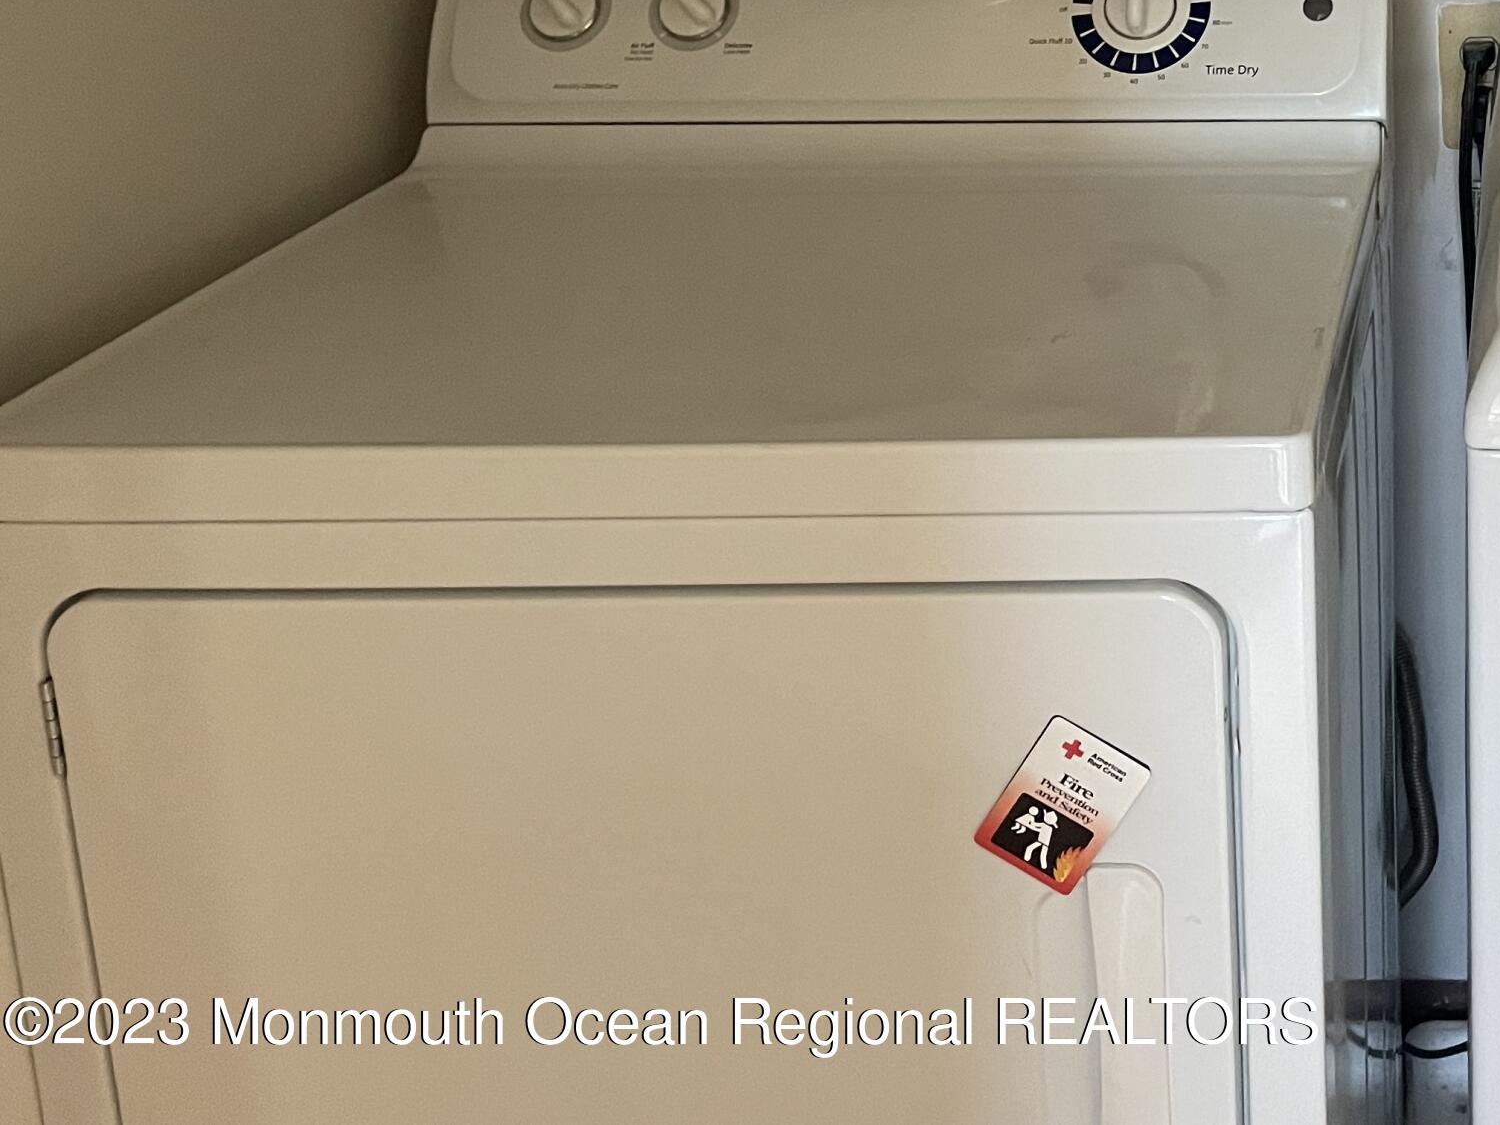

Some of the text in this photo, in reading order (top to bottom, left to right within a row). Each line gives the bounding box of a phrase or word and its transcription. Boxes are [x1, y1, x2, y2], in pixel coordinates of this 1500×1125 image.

[1206, 65, 1259, 78] Time Dry
[1087, 758, 1123, 782] Red Cross
[1091, 753, 1126, 777] American
[1040, 777, 1100, 817] Prevention
[1058, 773, 1095, 801] Fire
[1035, 789, 1093, 825] and Safety
